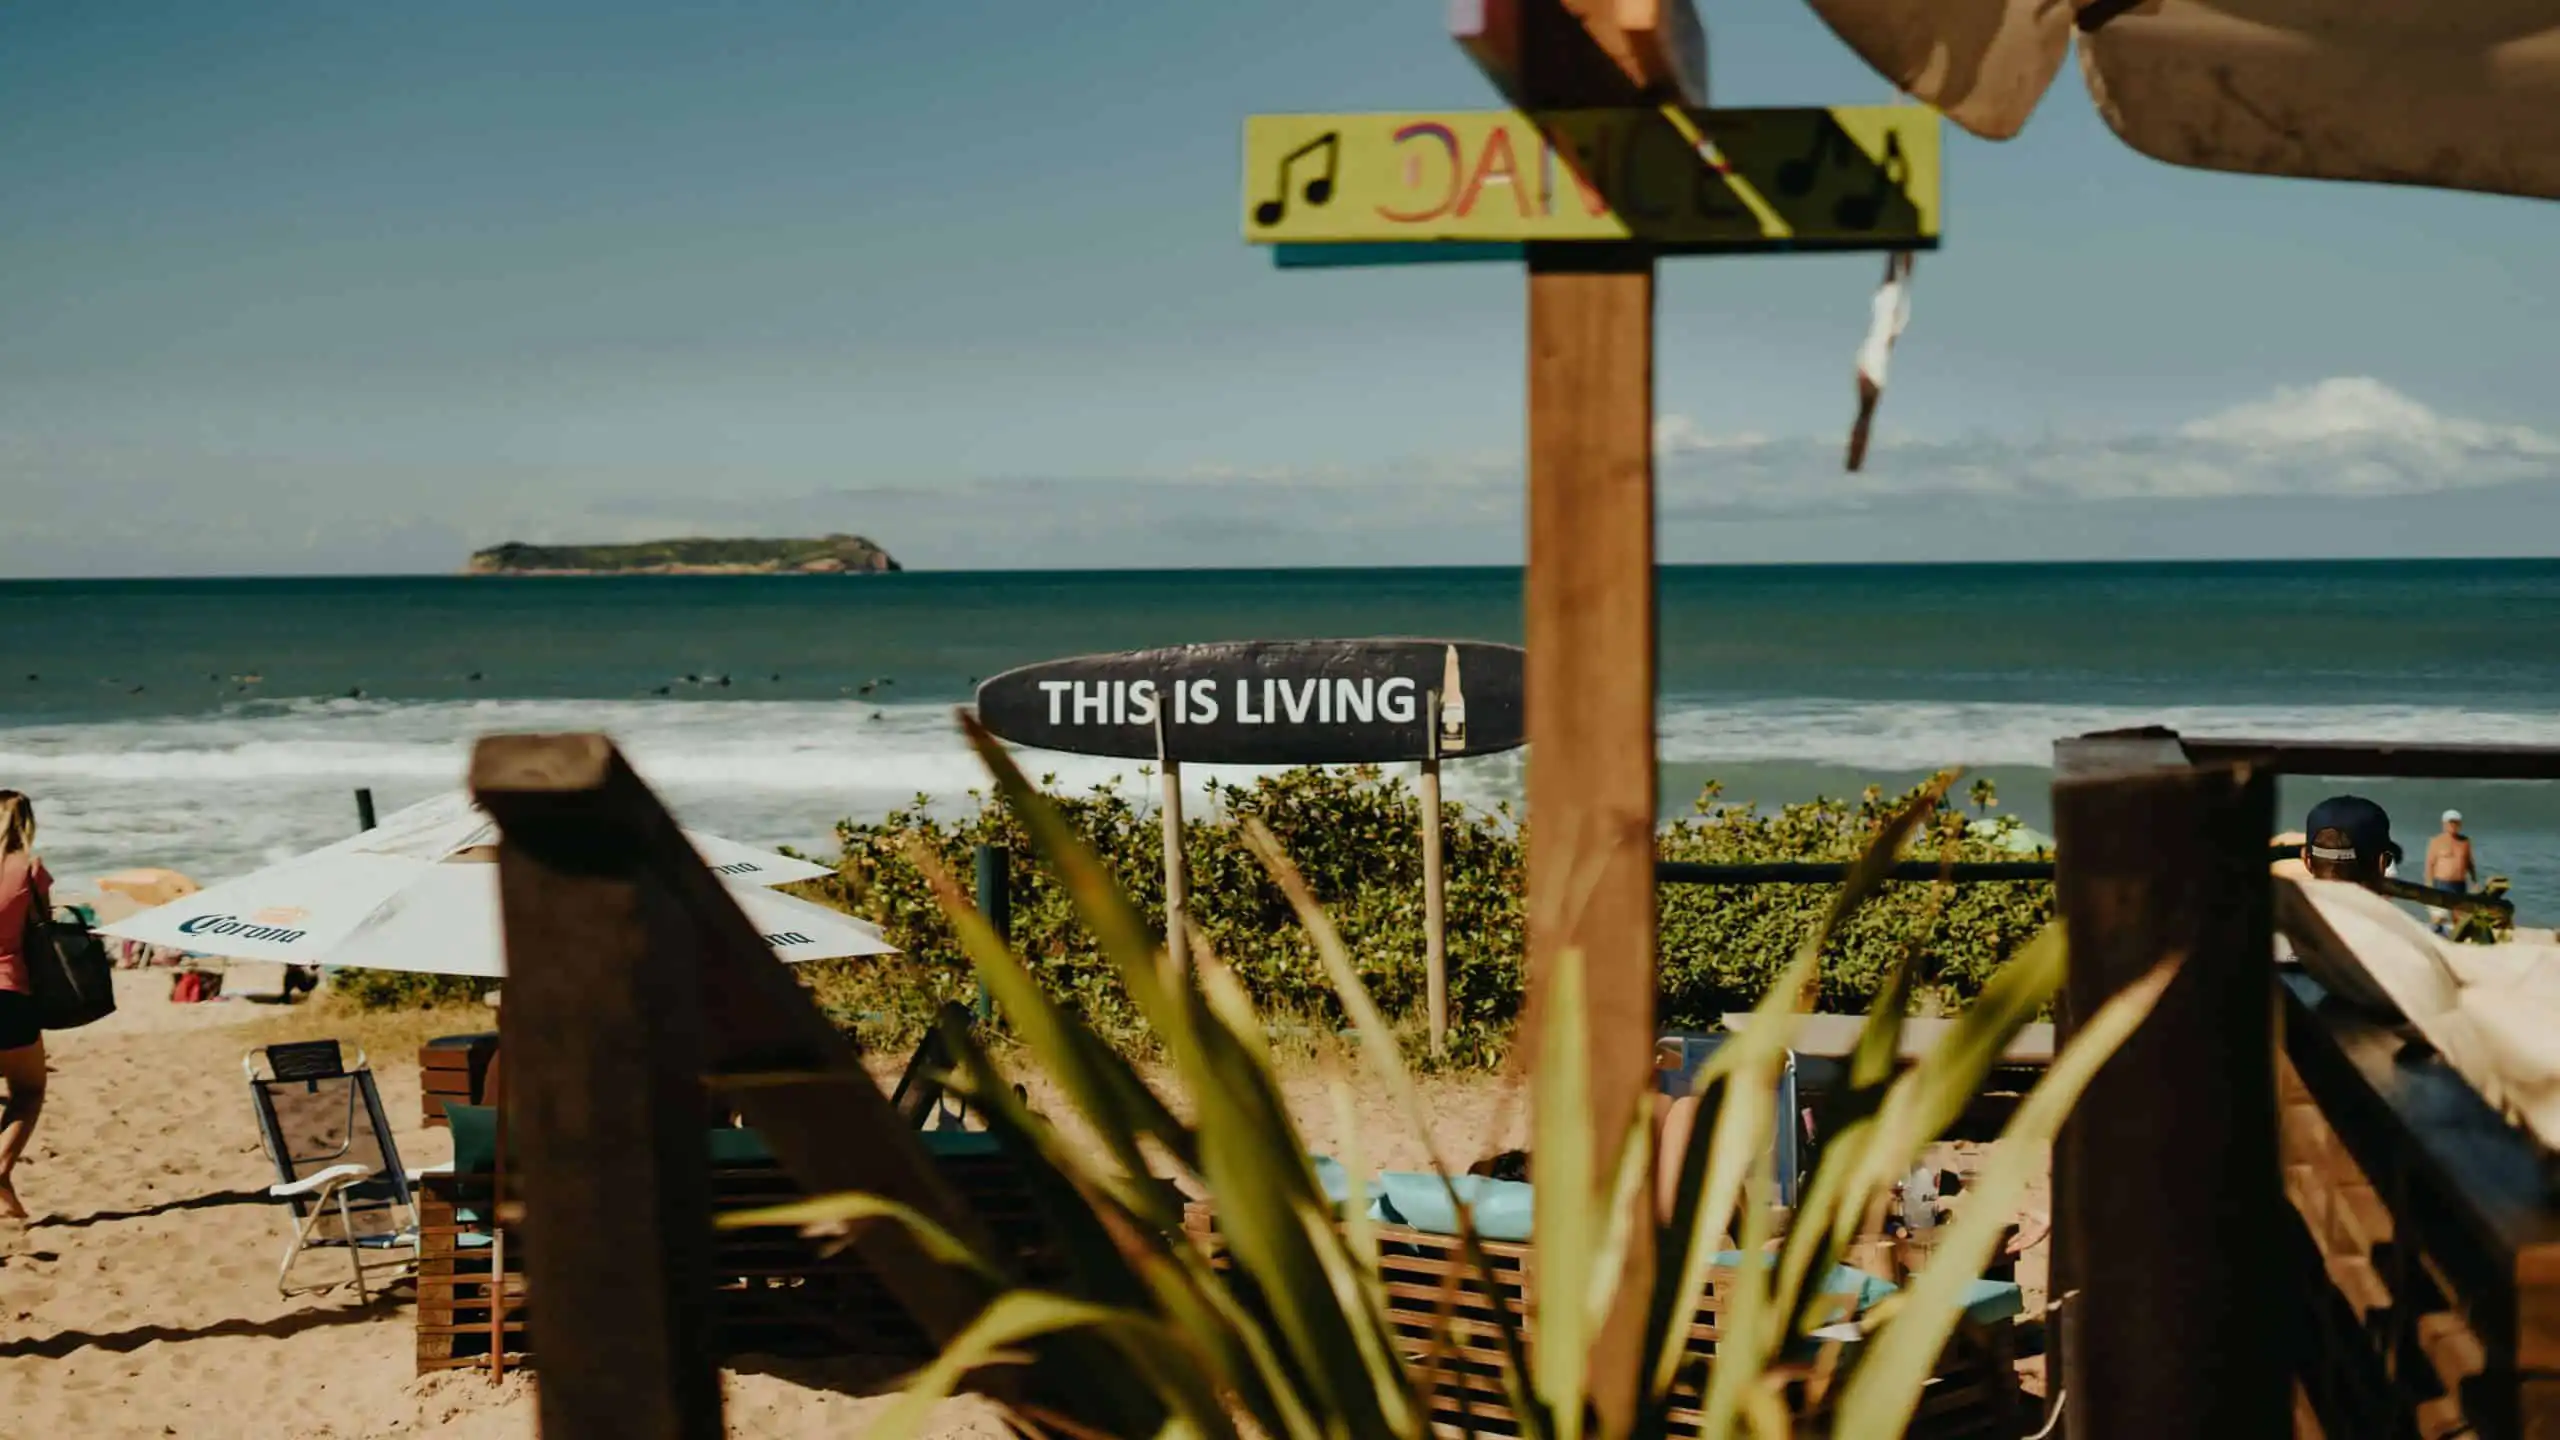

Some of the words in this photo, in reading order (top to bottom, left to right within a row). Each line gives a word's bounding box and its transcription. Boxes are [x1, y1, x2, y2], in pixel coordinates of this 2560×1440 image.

[1376, 120, 1752, 223] DANCE
[1038, 680, 1156, 725] THIS
[1174, 679, 1219, 724] IS
[1236, 677, 1416, 724] LIVING
[178, 913, 306, 943] Corona
